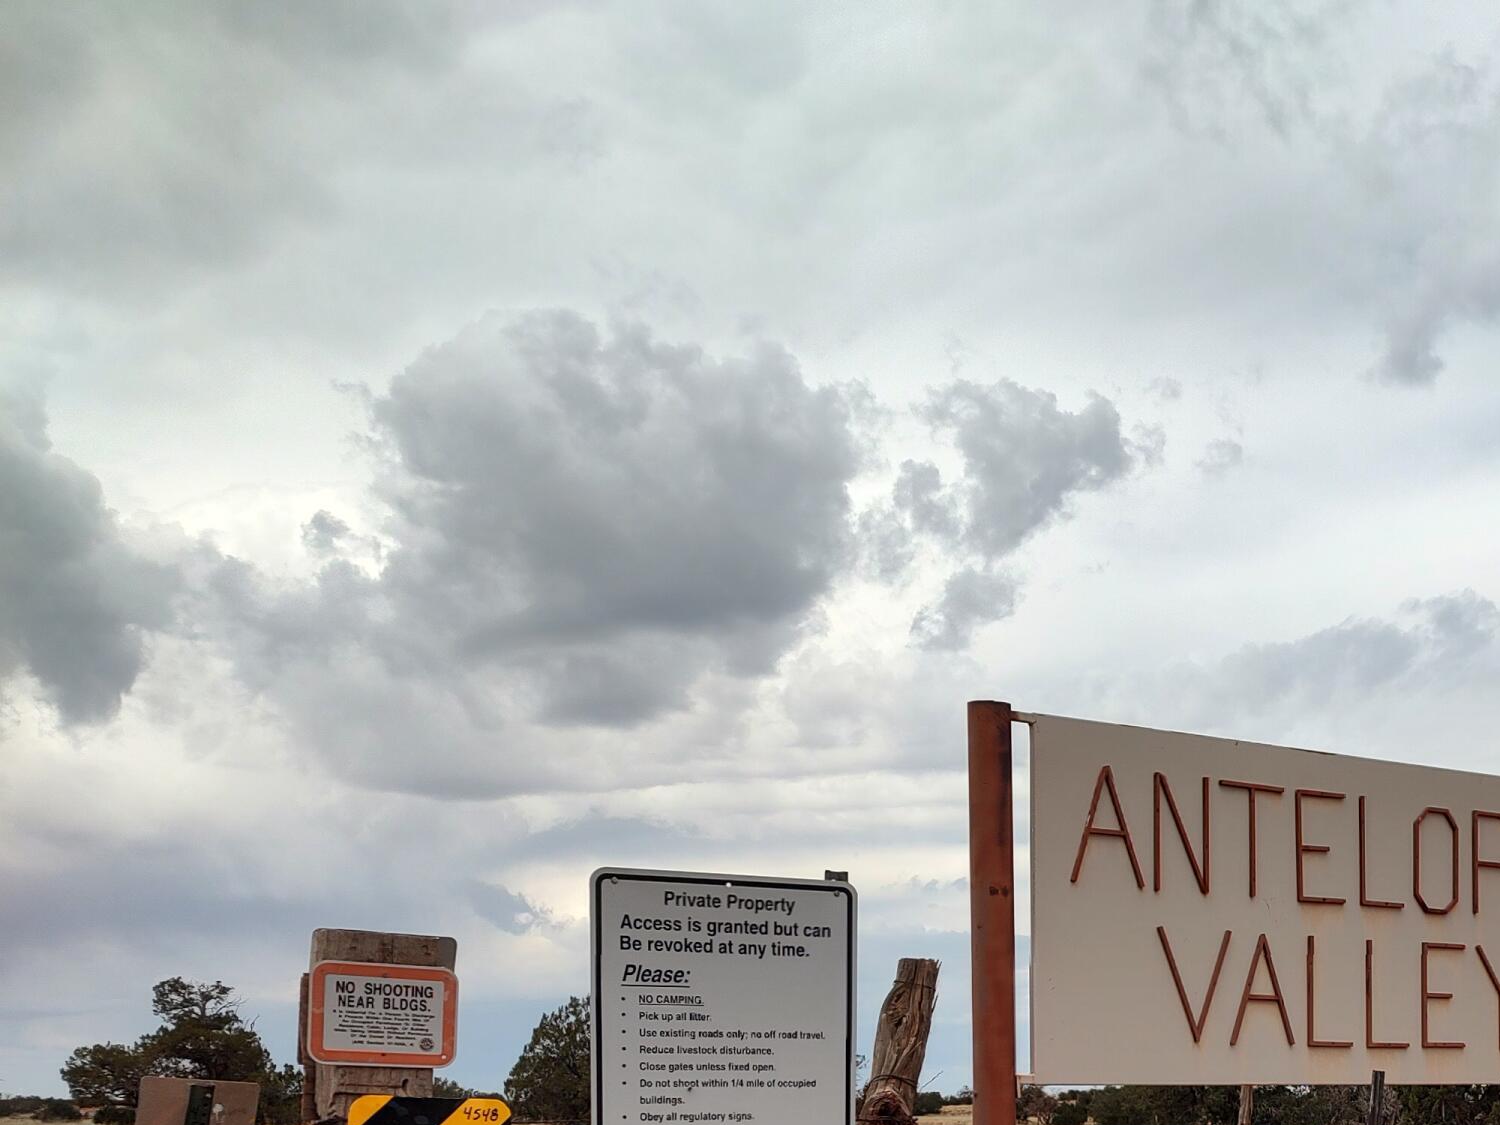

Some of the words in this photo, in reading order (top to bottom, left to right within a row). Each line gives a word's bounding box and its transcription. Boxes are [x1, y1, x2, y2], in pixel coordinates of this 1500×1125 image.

[664, 891, 721, 908] Private
[727, 894, 796, 915] Property
[621, 914, 682, 931] Access
[688, 917, 701, 932] is
[707, 921, 768, 936] granted
[774, 921, 798, 936] but
[803, 926, 831, 937] can
[620, 935, 642, 951] Be
[648, 938, 713, 953] revoked
[719, 940, 733, 954] at
[738, 944, 766, 959] any
[771, 941, 809, 957] time.
[622, 964, 690, 984] Please:
[336, 981, 356, 994] NO
[364, 983, 434, 998] SHOOTING
[338, 995, 376, 1008] NEAR
[383, 998, 431, 1012] BLDGS.
[639, 994, 653, 1004] NO
[655, 995, 704, 1005] CAMPING.
[639, 1011, 660, 1020] Pick
[661, 1013, 674, 1022] up
[675, 1012, 687, 1021] all
[689, 1012, 711, 1021] litter.
[639, 1028, 657, 1037] Use
[660, 1028, 698, 1040] existing
[698, 1029, 724, 1038] roads
[726, 1029, 748, 1041] only;
[764, 1030, 776, 1039] off
[778, 1031, 798, 1039] road
[800, 1031, 825, 1039] travel.
[640, 1044, 675, 1055] Reduce
[677, 1045, 717, 1055] livestock
[720, 1045, 774, 1055] disturbance.
[639, 1062, 666, 1071] Close
[669, 1063, 694, 1072] gates
[696, 1062, 727, 1071] unless
[728, 1062, 750, 1071] fixed
[752, 1064, 776, 1073] open.
[640, 1079, 653, 1088] Do
[655, 1079, 671, 1087] not
[673, 1079, 699, 1088] shoot
[701, 1078, 728, 1087] within
[731, 1079, 744, 1087] 1/4
[746, 1079, 765, 1087] mile
[767, 1079, 776, 1088] of
[777, 1079, 816, 1089] occupied
[640, 1096, 685, 1106] buildings.
[463, 1107, 499, 1122] 4548
[640, 1112, 664, 1122] Obey
[666, 1112, 677, 1121] all
[680, 1112, 726, 1122] regulatory
[728, 1112, 755, 1122] signs.
